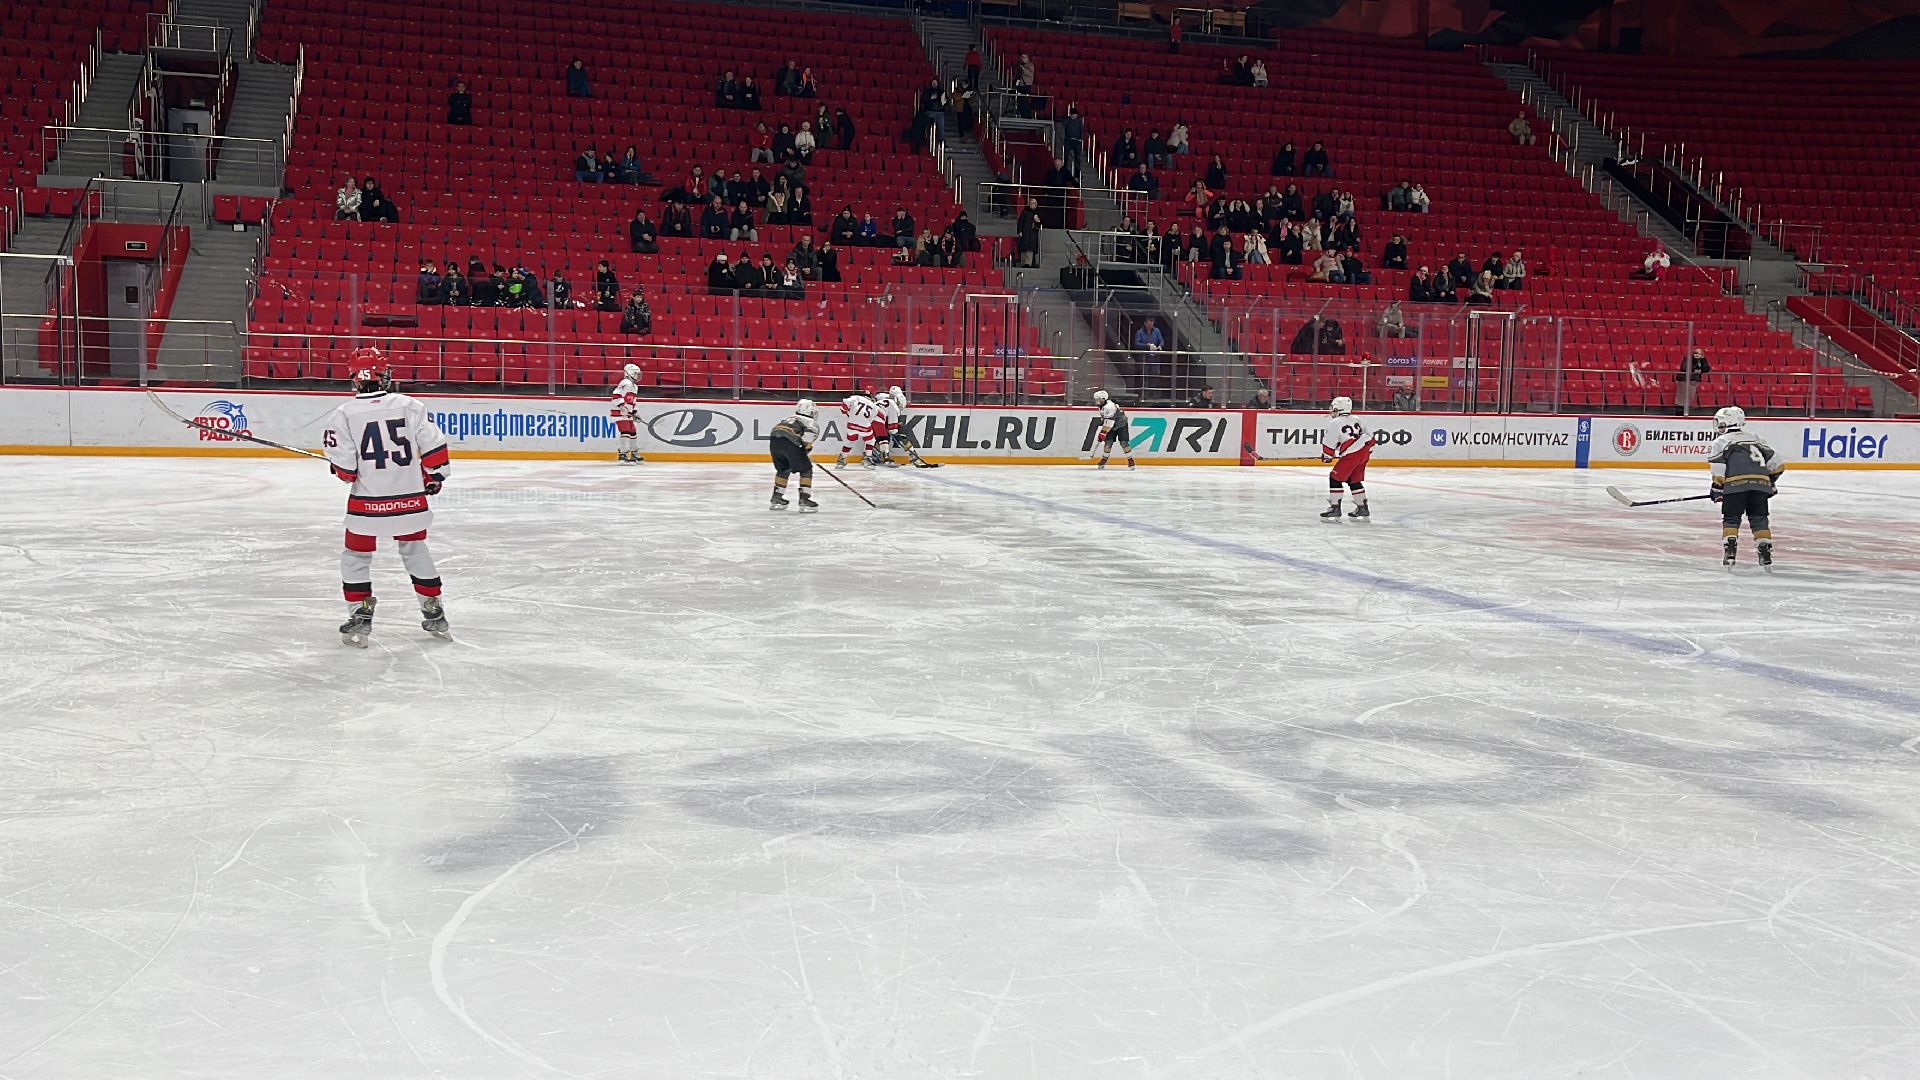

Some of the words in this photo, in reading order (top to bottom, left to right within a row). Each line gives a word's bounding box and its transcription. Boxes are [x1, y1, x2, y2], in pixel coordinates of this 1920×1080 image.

[358, 369, 371, 380] 45
[855, 402, 873, 418] 75
[434, 409, 616, 442] вернефтегазпром
[898, 415, 1056, 451] KHL.RU
[324, 429, 338, 448] 45
[361, 418, 412, 469] 45
[1266, 428, 1413, 446] ТИНФФ
[1451, 432, 1569, 446] VK.COM/HCVITYAZ
[1645, 430, 1694, 441] БИЛЕТЫ
[1697, 431, 1721, 442] ОНЛ
[1802, 426, 1889, 459] Haier
[364, 499, 421, 512] ПОДОЛЬСК
